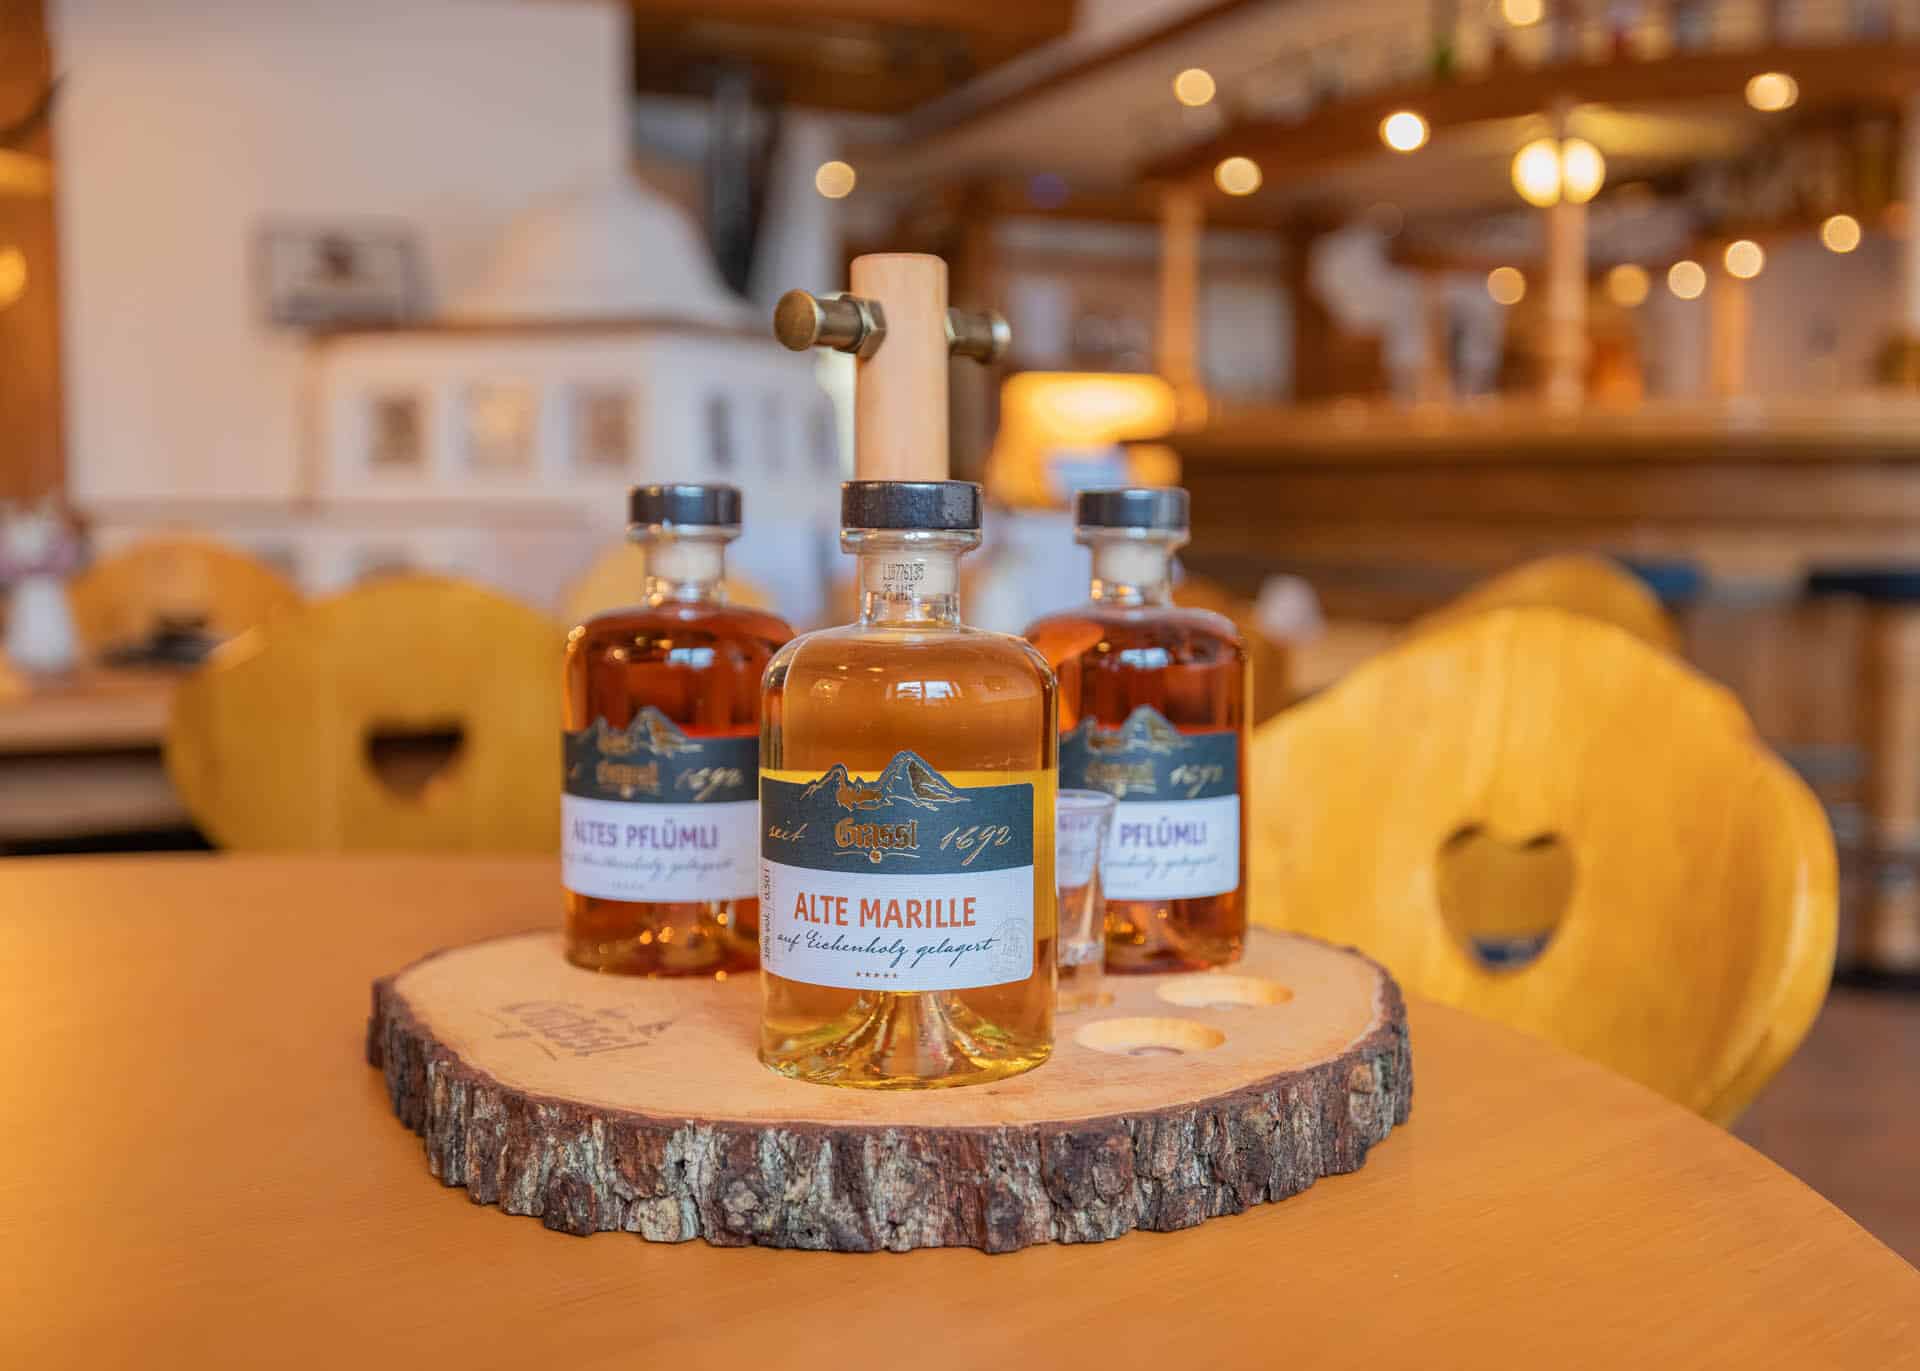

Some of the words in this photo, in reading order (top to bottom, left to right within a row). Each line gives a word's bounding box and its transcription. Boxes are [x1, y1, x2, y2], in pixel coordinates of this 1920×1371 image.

[572, 818, 618, 848] ALTES
[625, 817, 719, 849] PFLÜMLI
[768, 820, 808, 841] seit
[834, 817, 920, 850] Grassl
[940, 824, 1012, 866] 1692
[1119, 816, 1207, 847] PFLÜMLI
[794, 892, 849, 926] ALTE
[859, 896, 977, 929] MARILLE
[777, 932, 802, 952] auf
[805, 929, 907, 968] Eichenholz
[911, 937, 1000, 968] gelagert
